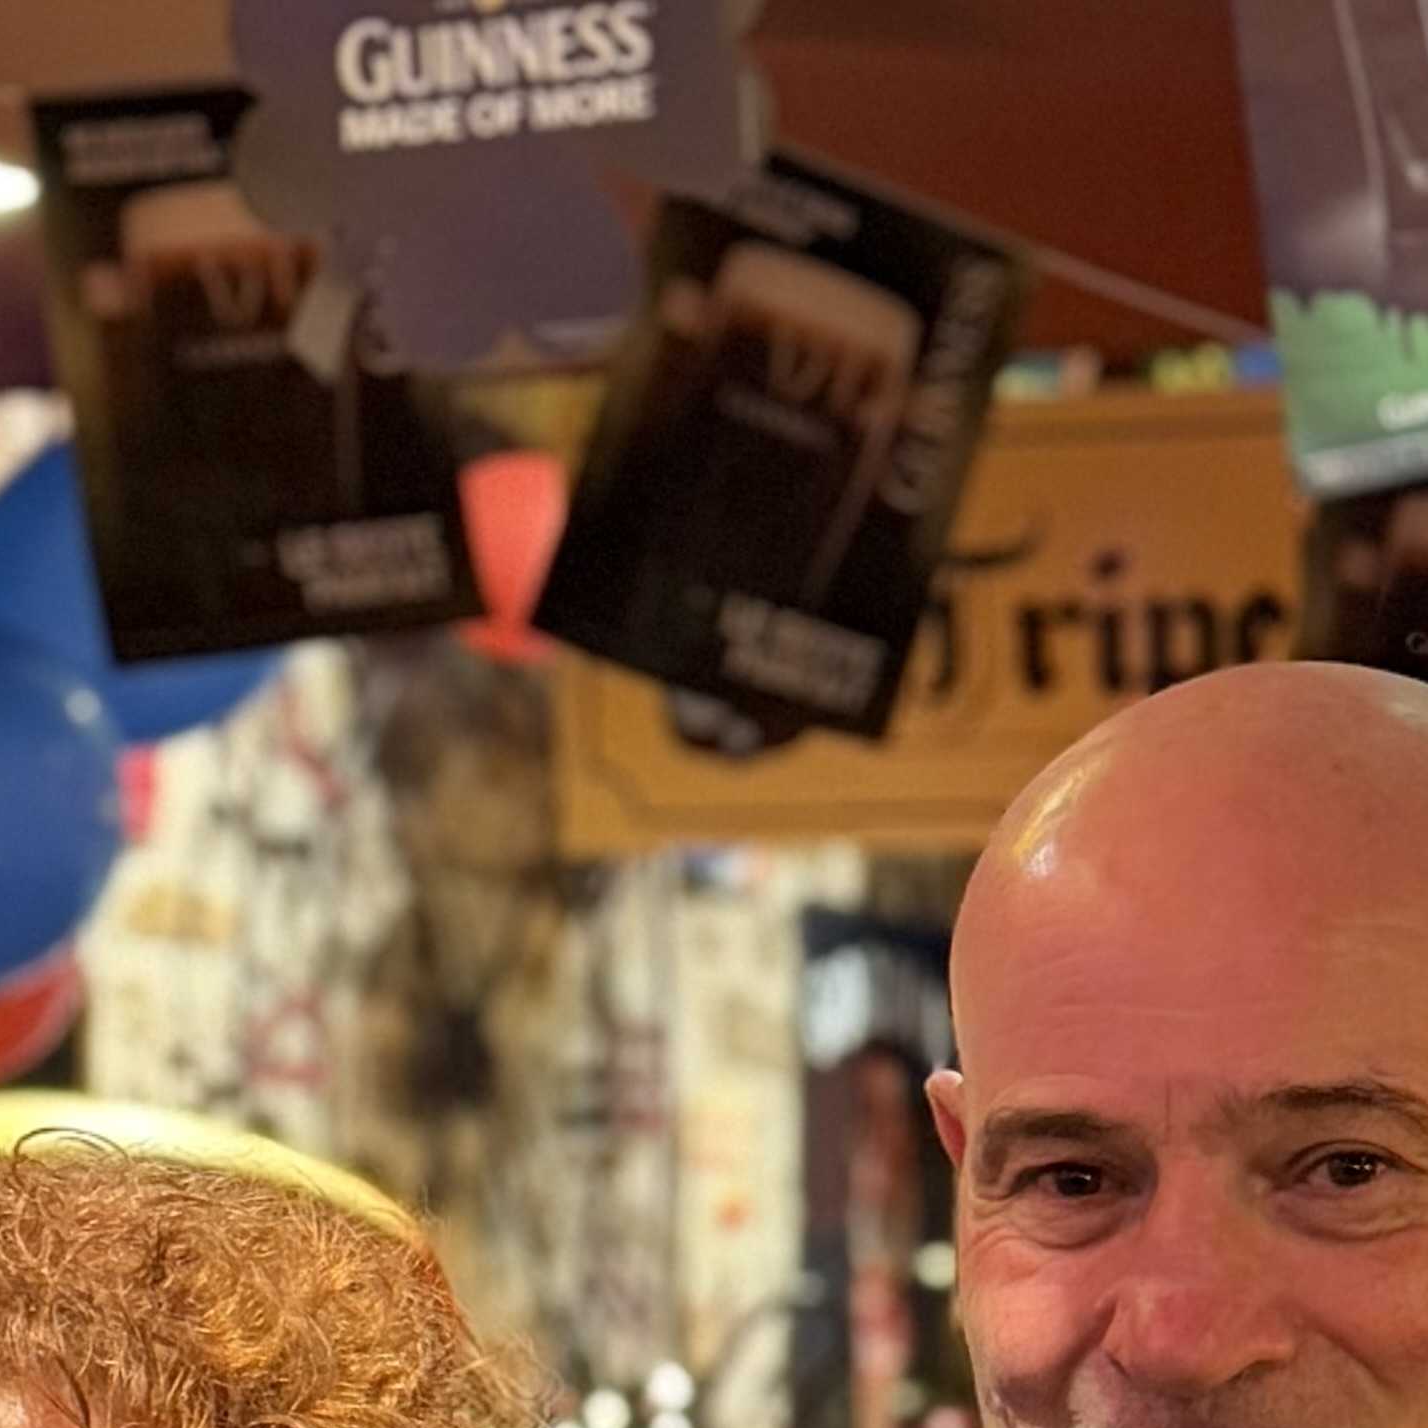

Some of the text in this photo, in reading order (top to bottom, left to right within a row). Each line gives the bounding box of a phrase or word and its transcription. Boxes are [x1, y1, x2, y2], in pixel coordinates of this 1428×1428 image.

[334, 0, 658, 104] GUINNESS
[338, 73, 659, 153] MADE OF MORE
